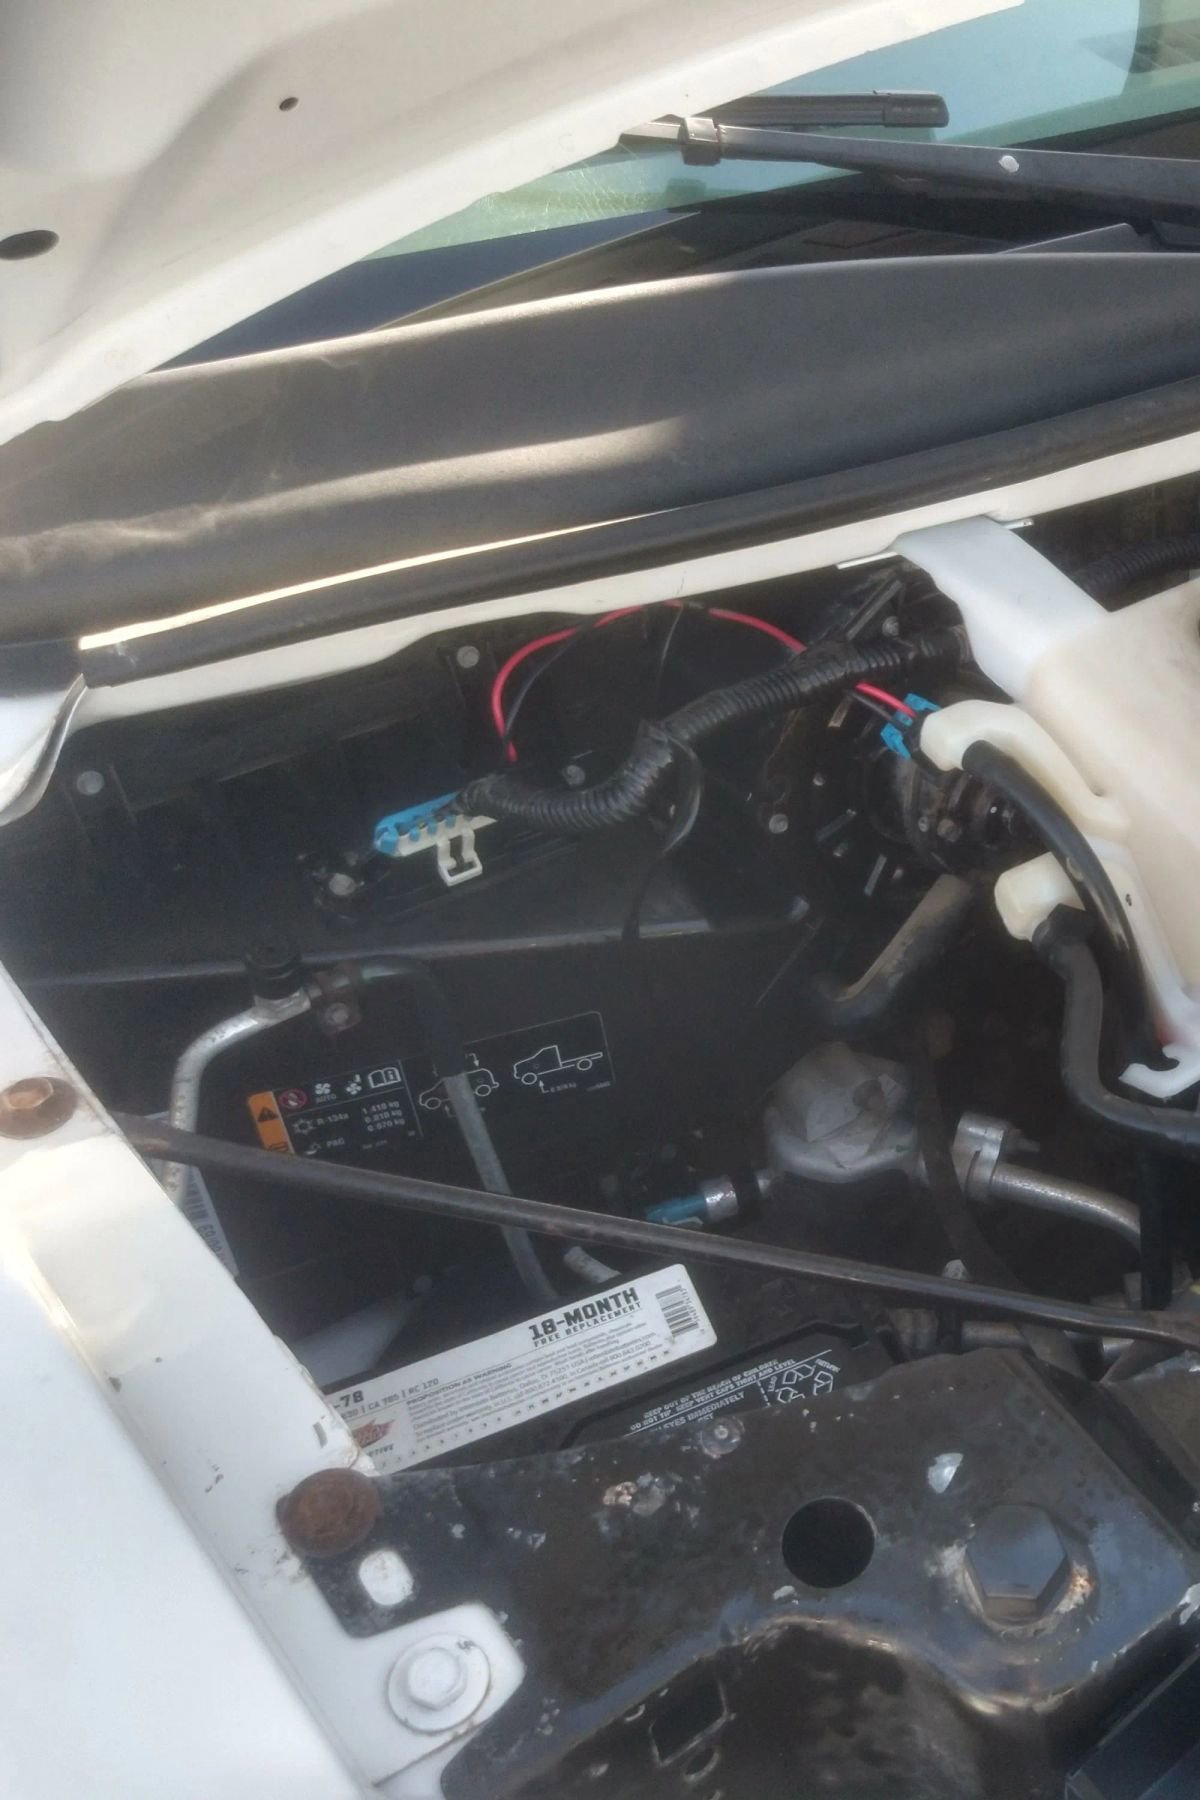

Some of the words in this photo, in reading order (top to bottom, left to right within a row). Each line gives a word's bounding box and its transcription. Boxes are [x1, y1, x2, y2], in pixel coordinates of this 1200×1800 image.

[528, 1286, 640, 1340] 18-MONTH
[533, 1333, 561, 1348] FREE
[565, 1301, 642, 1336] REPLACEMENT
[735, 1374, 758, 1387] TIGHT
[758, 1367, 774, 1378] AND
[774, 1359, 796, 1371] LEVEL
[368, 1402, 380, 1411] CA
[664, 1399, 678, 1411] OUT
[691, 1390, 706, 1401] THE
[688, 1392, 745, 1421] IMMEDIATELY
